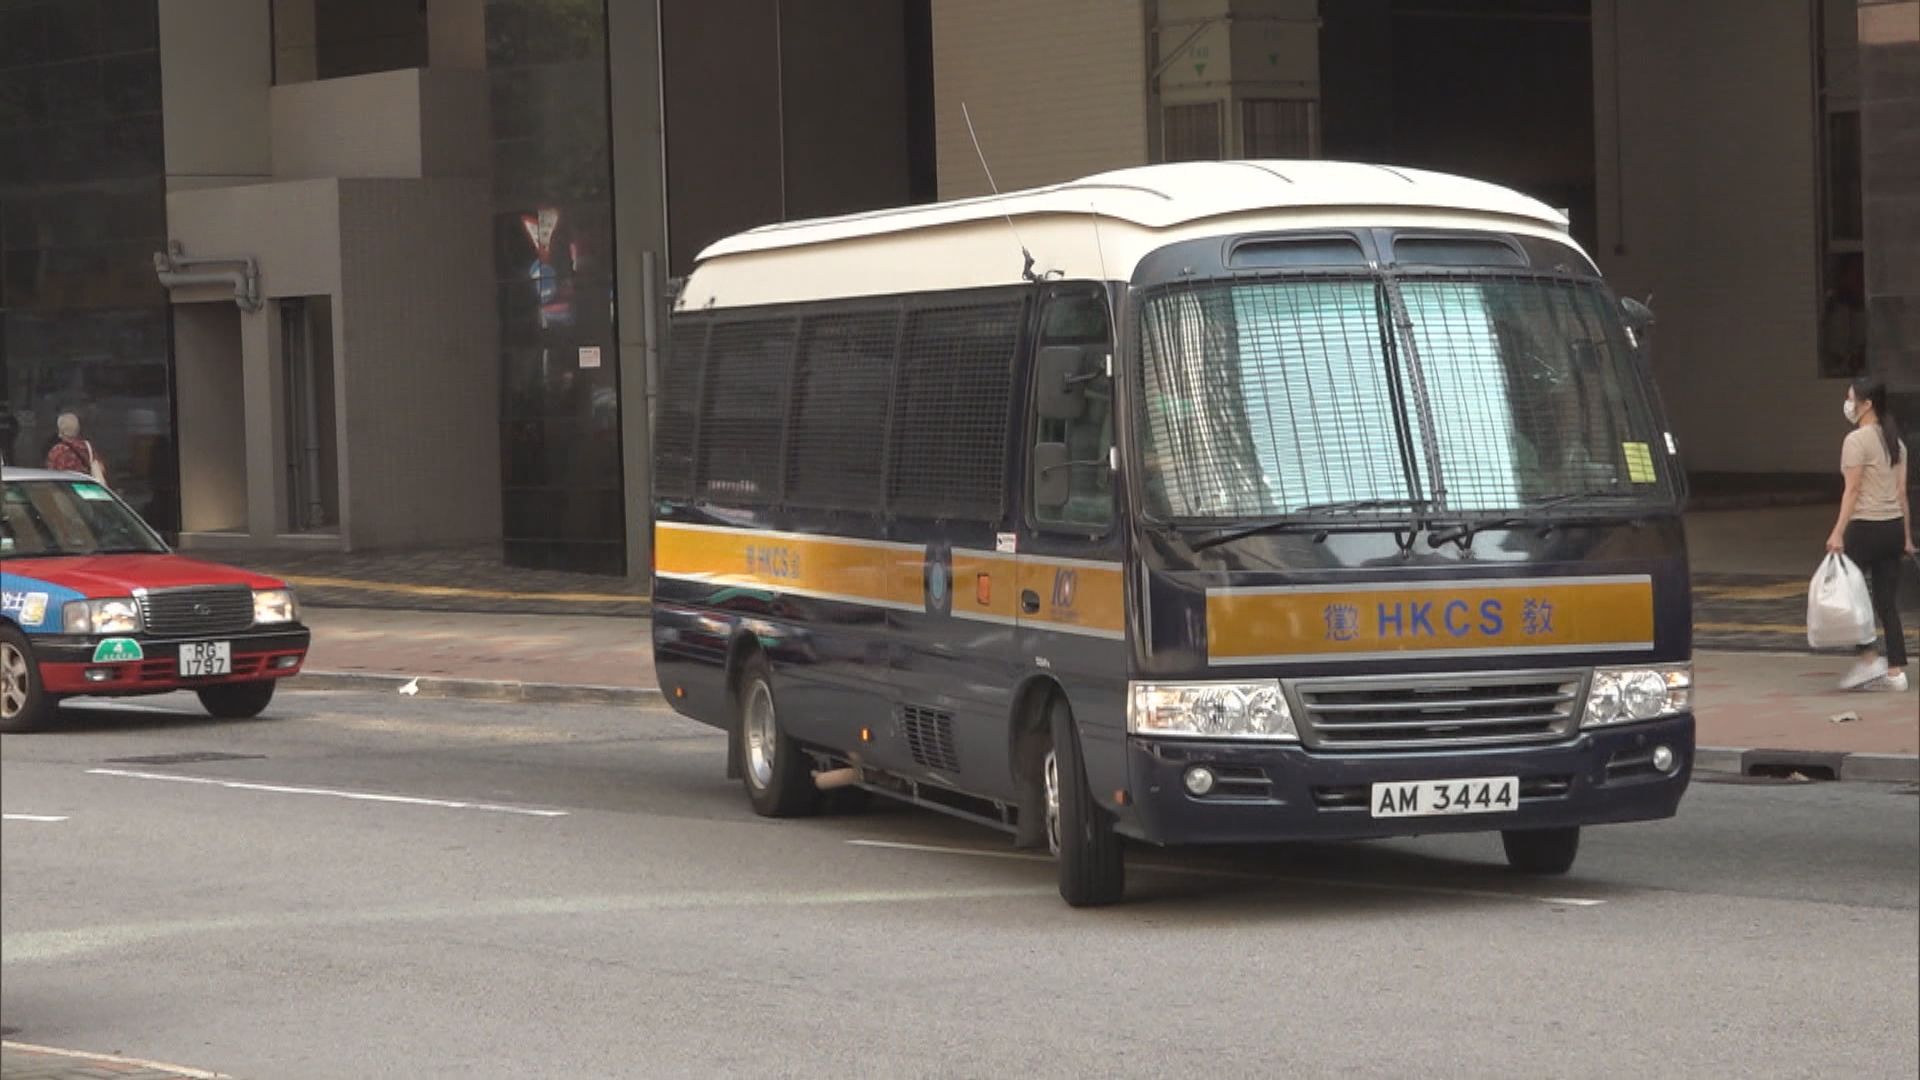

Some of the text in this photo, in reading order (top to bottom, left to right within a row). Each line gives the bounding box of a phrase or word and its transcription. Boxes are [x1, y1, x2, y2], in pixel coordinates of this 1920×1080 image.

[759, 545, 788, 576] HKCS
[1323, 603, 1359, 641] 懲
[1377, 598, 1504, 638] HKCS
[195, 640, 216, 659] RG
[186, 657, 225, 675] 1797
[1378, 782, 1512, 813] AM 3444
